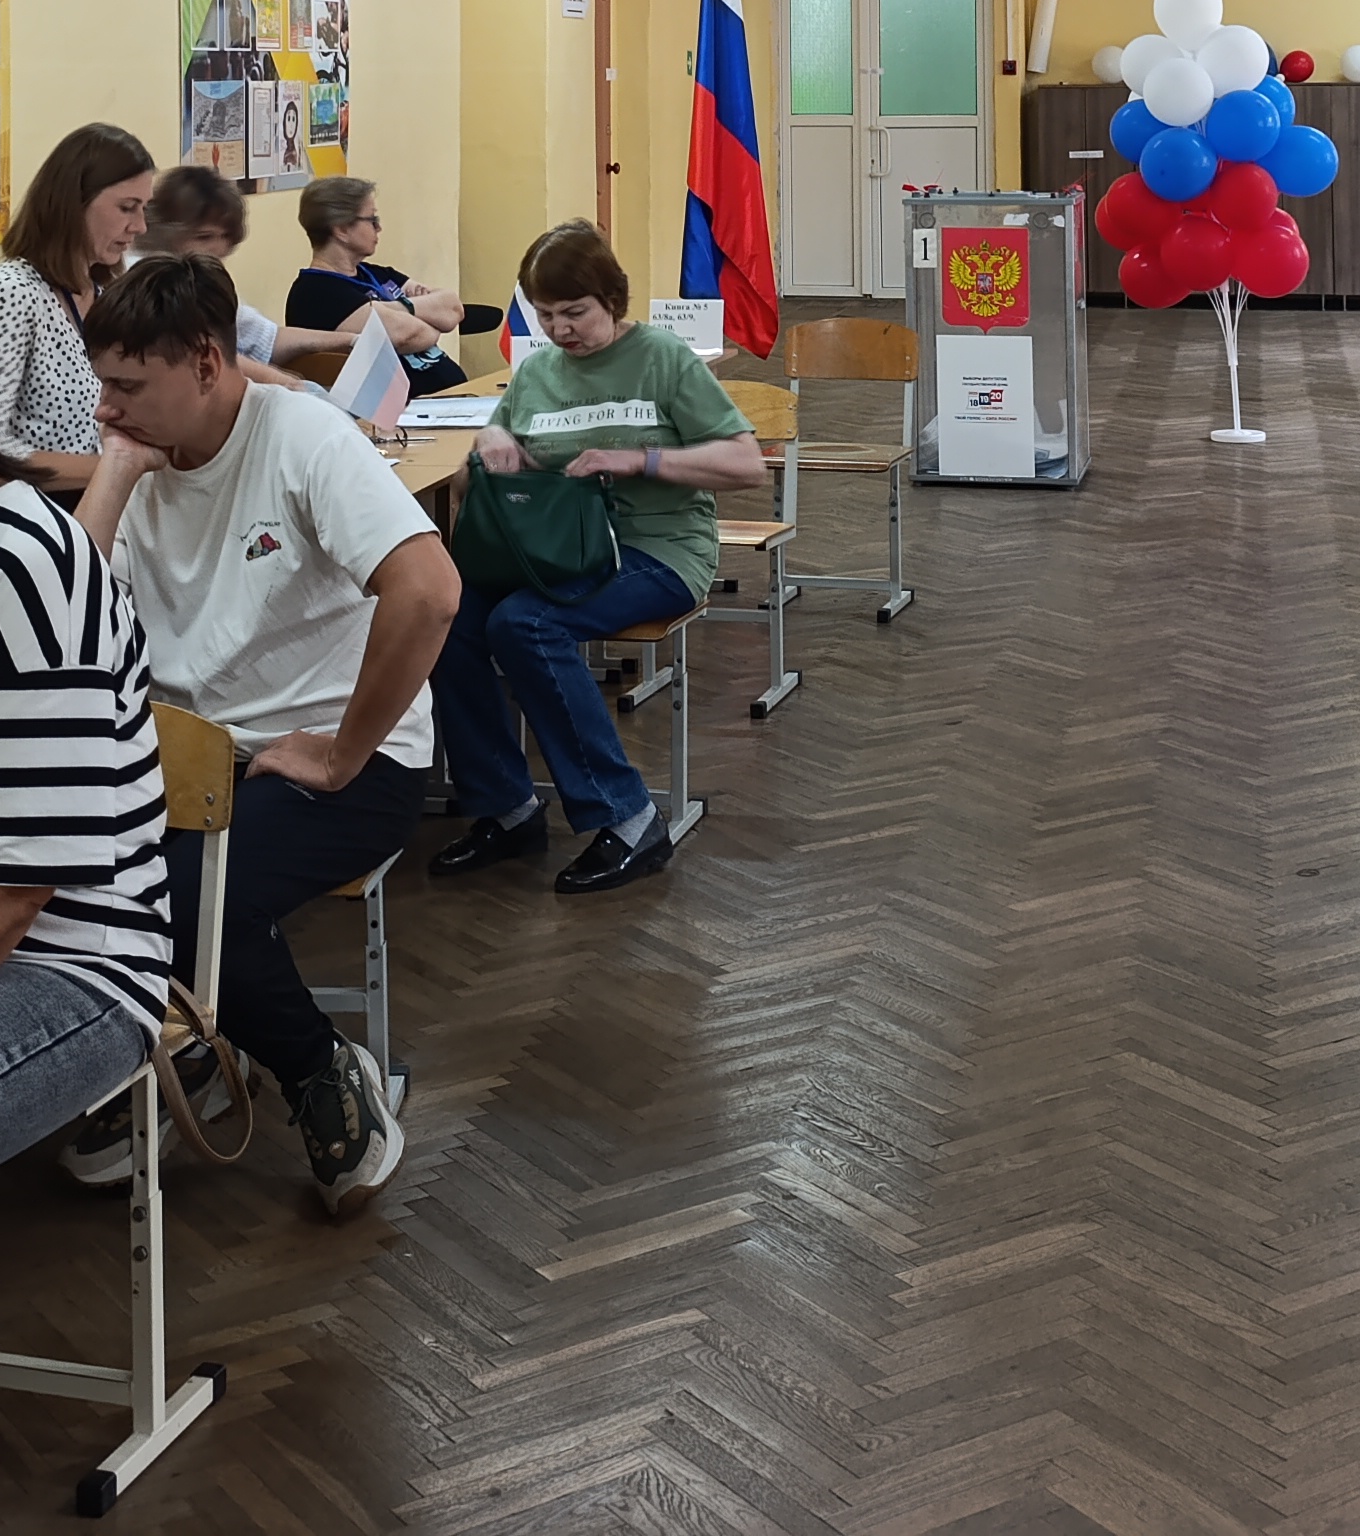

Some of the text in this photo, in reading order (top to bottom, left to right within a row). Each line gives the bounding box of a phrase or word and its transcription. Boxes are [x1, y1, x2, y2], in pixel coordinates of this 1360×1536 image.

[921, 237, 930, 261] 1
[665, 303, 690, 311] Книга
[703, 303, 708, 311] 5
[969, 398, 979, 407] 18
[990, 391, 1001, 400] 20
[531, 406, 656, 431] LIVING FOR THE
